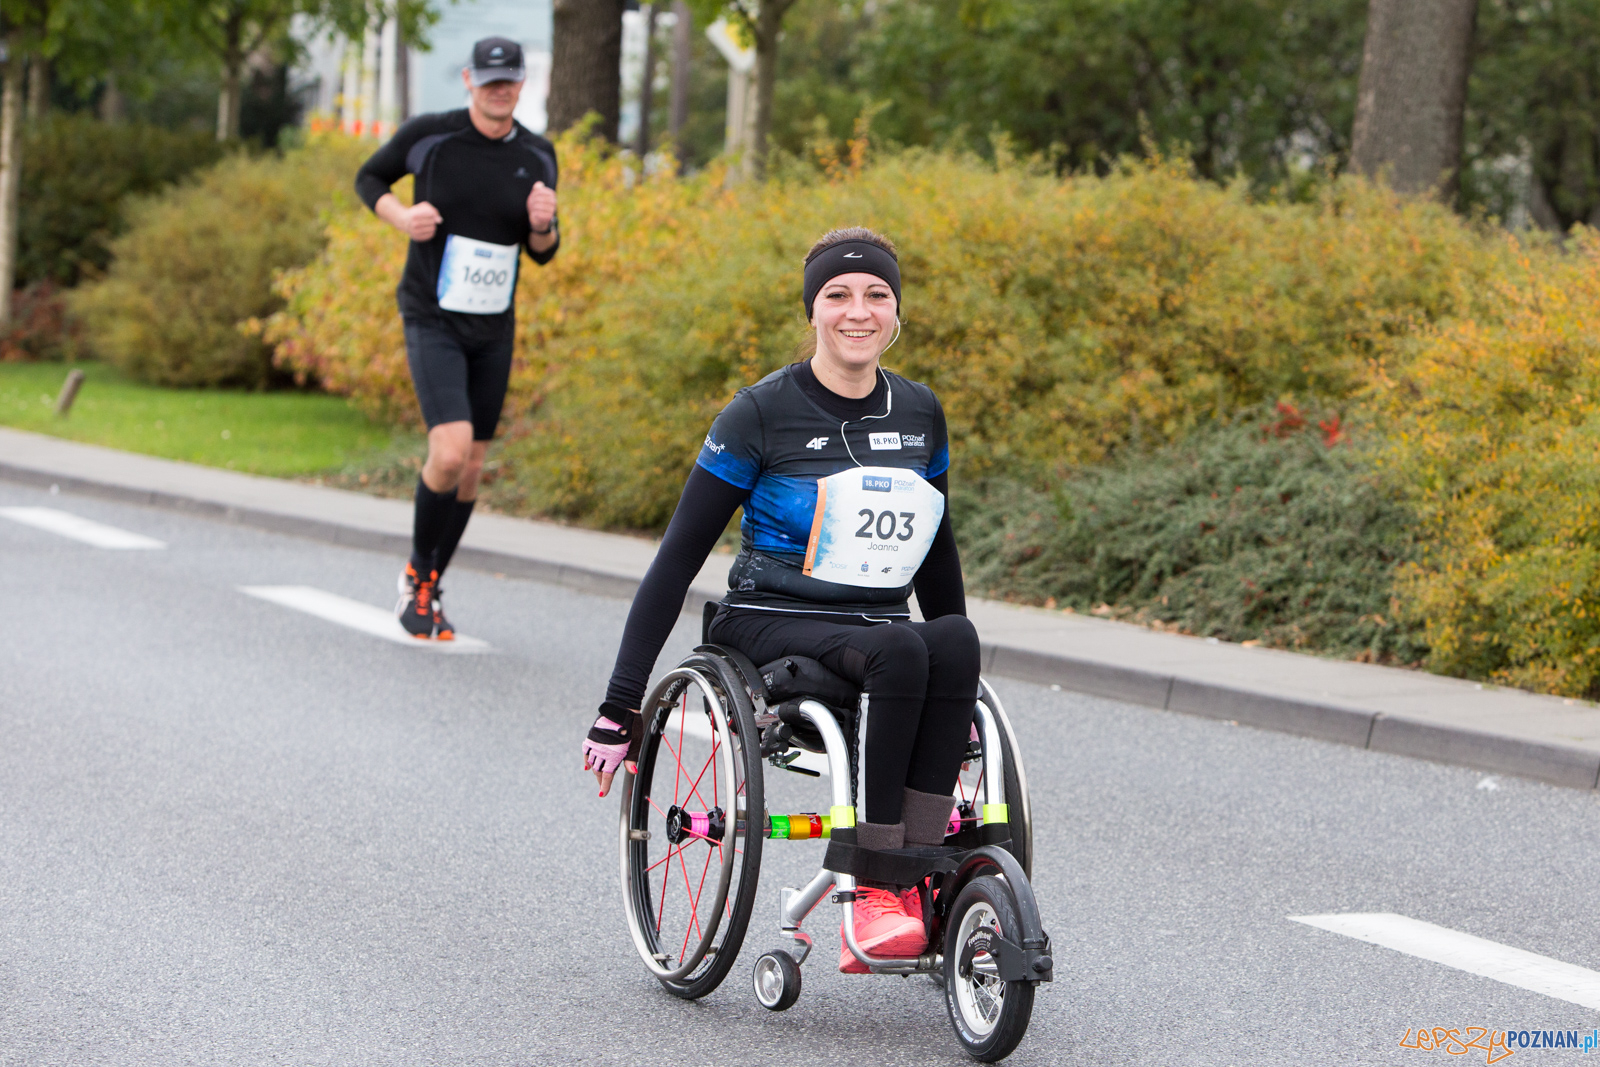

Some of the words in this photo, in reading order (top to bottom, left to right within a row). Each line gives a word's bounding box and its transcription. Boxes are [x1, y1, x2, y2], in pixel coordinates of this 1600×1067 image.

[463, 266, 508, 286] 1600
[806, 437, 829, 450] 4F
[855, 508, 916, 541] 203
[867, 541, 899, 552] Joanna
